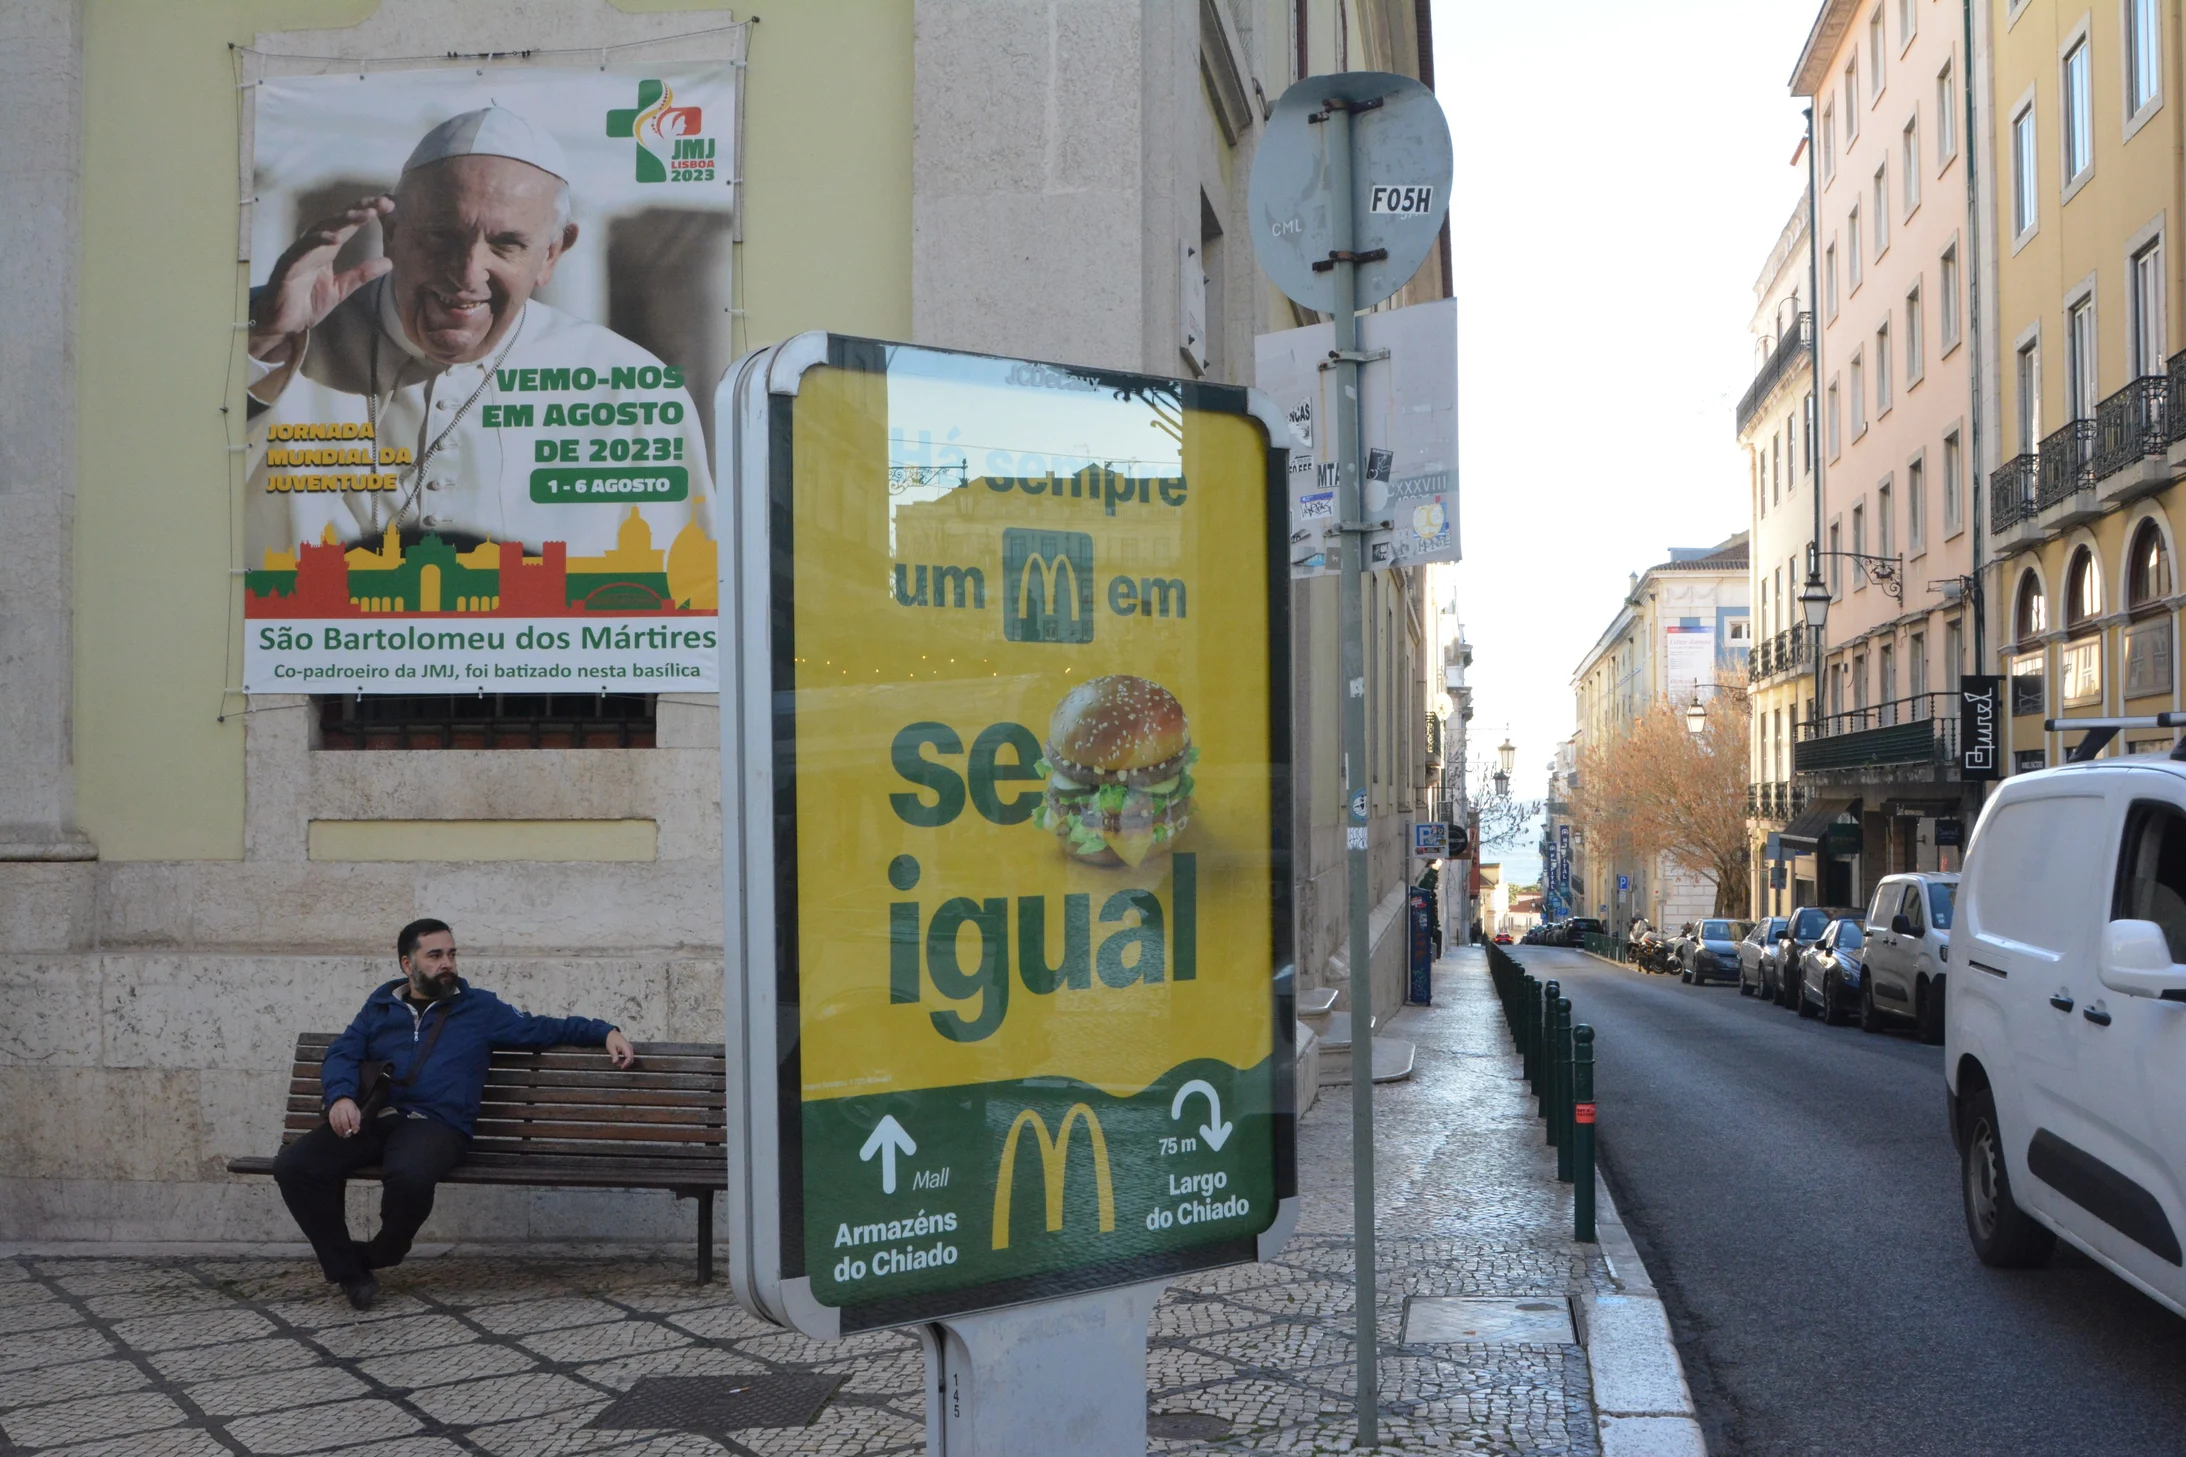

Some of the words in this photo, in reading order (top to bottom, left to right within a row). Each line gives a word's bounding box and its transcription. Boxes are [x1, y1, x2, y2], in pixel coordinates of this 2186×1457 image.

[671, 138, 715, 160] JMJ
[671, 160, 715, 169] LISBOA
[671, 169, 715, 182] 2023
[1272, 218, 1302, 237] CML
[497, 366, 685, 392] VEMO-NOS
[482, 405, 533, 428] EM
[543, 401, 684, 427] AGOSTO
[267, 423, 376, 441] JORNADA
[267, 449, 374, 467] MUNDIAL
[379, 447, 412, 465] DA
[535, 440, 581, 463] DE
[590, 438, 684, 462] 2023!
[889, 426, 961, 489] Há
[984, 446, 1188, 516] sempre
[266, 474, 398, 493] JUVENTUDE
[548, 480, 558, 493] 1
[575, 479, 587, 493] 6
[591, 478, 670, 493] AGOSTO
[894, 562, 986, 609] um
[1107, 574, 1187, 619] em
[259, 627, 313, 652] São
[324, 627, 505, 651] Bartolomeu
[515, 626, 571, 650] dos
[581, 623, 717, 650] Mártires
[274, 663, 390, 681] Co-padroeiro
[394, 663, 417, 679] da
[421, 664, 460, 681] JMJ,
[466, 663, 489, 679] foi
[494, 663, 573, 679] batizado
[577, 665, 627, 679] nesta
[632, 662, 701, 678] basílica
[888, 721, 1047, 828] se
[1620, 877, 1626, 887] P
[887, 853, 1197, 1043] igual
[1158, 1138, 1178, 1155] 75
[1180, 1139, 1197, 1153] m
[913, 1167, 949, 1191] Mall
[1169, 1171, 1227, 1198] Largo
[1146, 1206, 1173, 1231] do
[1176, 1196, 1250, 1226] Chiado
[834, 1208, 958, 1248] Armazéns
[834, 1257, 867, 1282] do
[872, 1245, 958, 1277] Chiado
